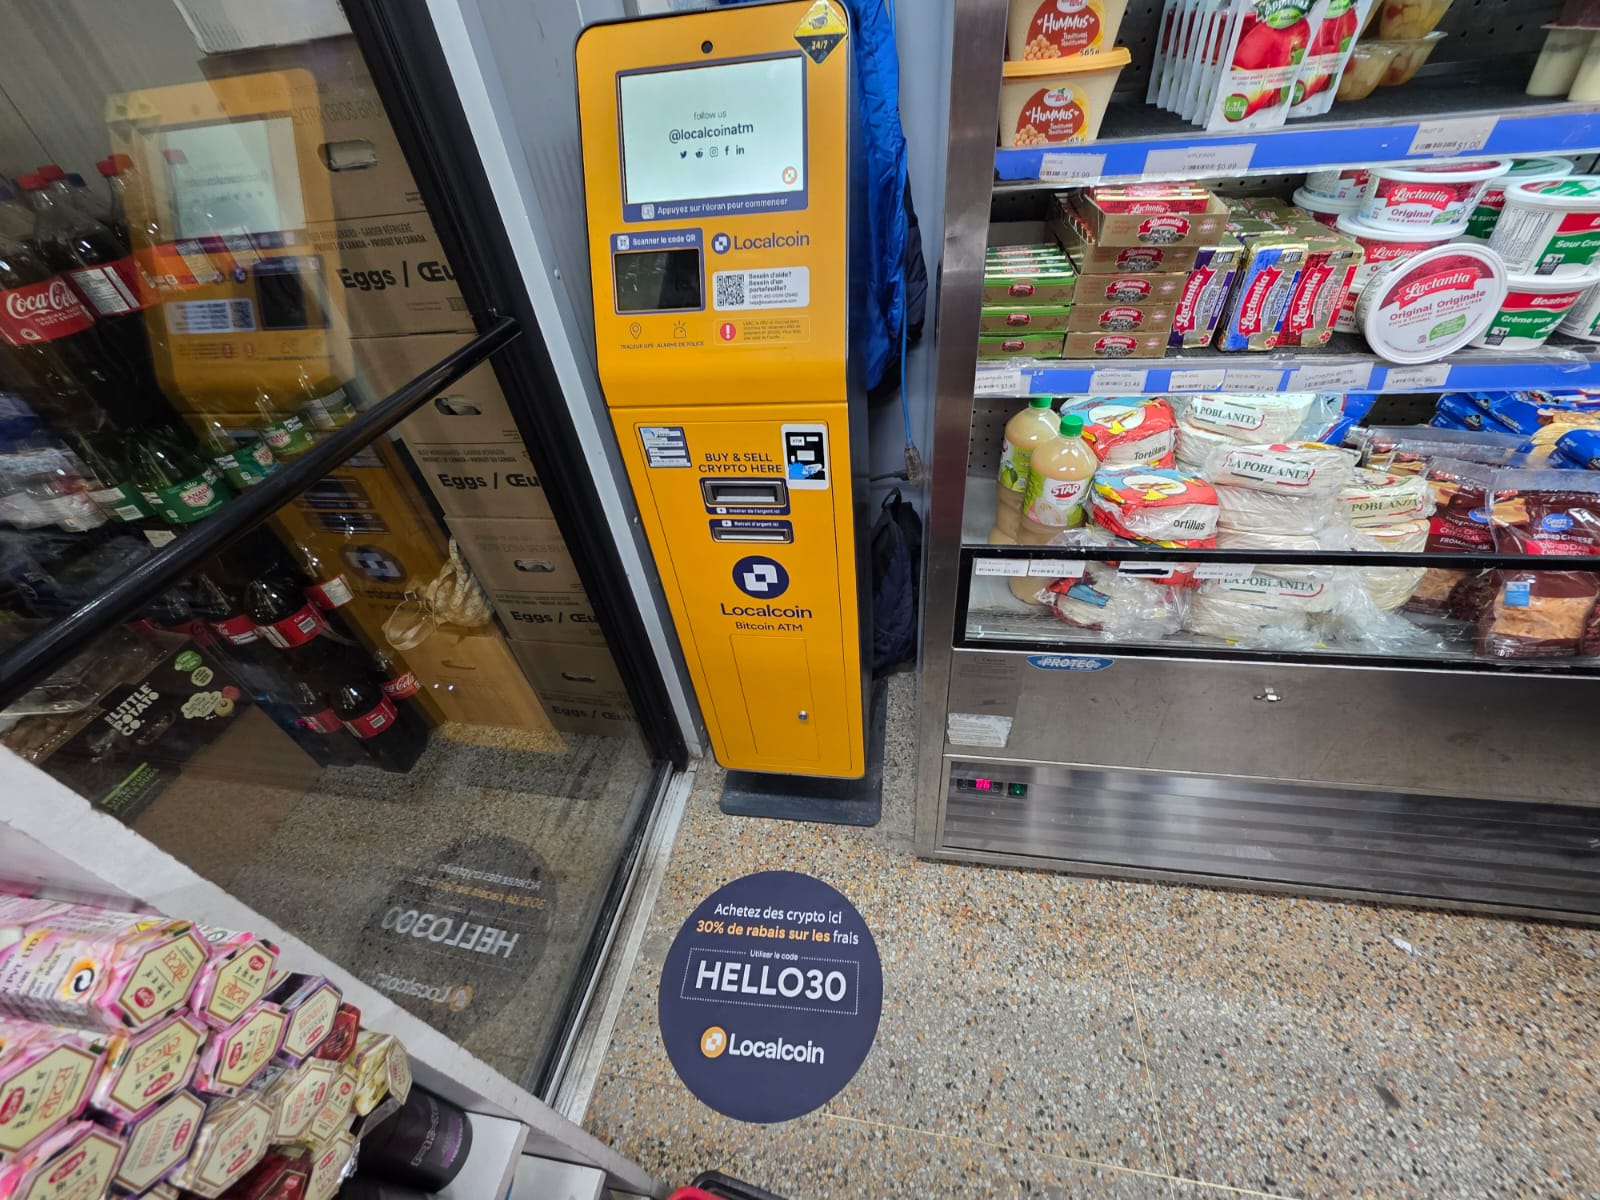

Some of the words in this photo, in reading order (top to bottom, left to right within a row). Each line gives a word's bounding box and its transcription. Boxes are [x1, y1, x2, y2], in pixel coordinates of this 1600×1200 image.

[811, 40, 828, 50] 24/7
[693, 111, 716, 120] follow
[717, 110, 727, 119] us
[669, 122, 754, 144] @localcoinatm
[1391, 187, 1448, 202] Lactantia
[657, 205, 688, 216] Appuyez
[689, 205, 701, 213] sur
[727, 201, 743, 211] pour
[745, 197, 788, 209] commencer
[1391, 208, 1434, 218] Original
[659, 236, 666, 244] le
[667, 235, 685, 244] code
[685, 233, 696, 243] QR
[733, 230, 811, 250] Localcoin
[1555, 240, 1579, 249] Sour
[339, 268, 396, 290] Eggs
[1405, 273, 1470, 300] Lactantia
[1175, 275, 1203, 328] Lactantia
[1241, 275, 1270, 331] Lactantia
[1293, 273, 1322, 326] Lactantia
[1390, 304, 1432, 320] Original
[1437, 290, 1486, 308] Originale
[1501, 315, 1532, 323] Crème
[1200, 406, 1256, 425] POBLANITA
[705, 453, 728, 462] BUY
[733, 453, 741, 462] &
[744, 453, 773, 462] SELL
[1134, 446, 1167, 461] Tortillas
[699, 464, 747, 473] CRYPTO
[751, 464, 782, 473] HERE
[1243, 461, 1309, 480] POBLANITA
[437, 473, 487, 489] Eggs
[505, 474, 540, 487] Œu
[1051, 483, 1080, 496] STAR
[1172, 519, 1205, 530] ortillas
[510, 611, 553, 623] Eggs
[720, 603, 812, 619] Localcoin
[736, 621, 774, 631] Bitcoin
[777, 622, 803, 632] ATM
[112, 692, 159, 731] POTATO
[714, 903, 761, 919] Achetez
[763, 906, 784, 919] des
[787, 909, 825, 925] crypto
[696, 920, 724, 934] 30%
[727, 923, 744, 935] de
[746, 924, 786, 939] rabais
[788, 929, 809, 941] sur
[811, 928, 831, 942] les
[833, 930, 859, 945] frais
[750, 949, 774, 960] Utiliser
[774, 951, 780, 960] le
[781, 952, 799, 961] code
[695, 959, 847, 1002] HELLO30
[728, 1033, 825, 1065] Localcoin
